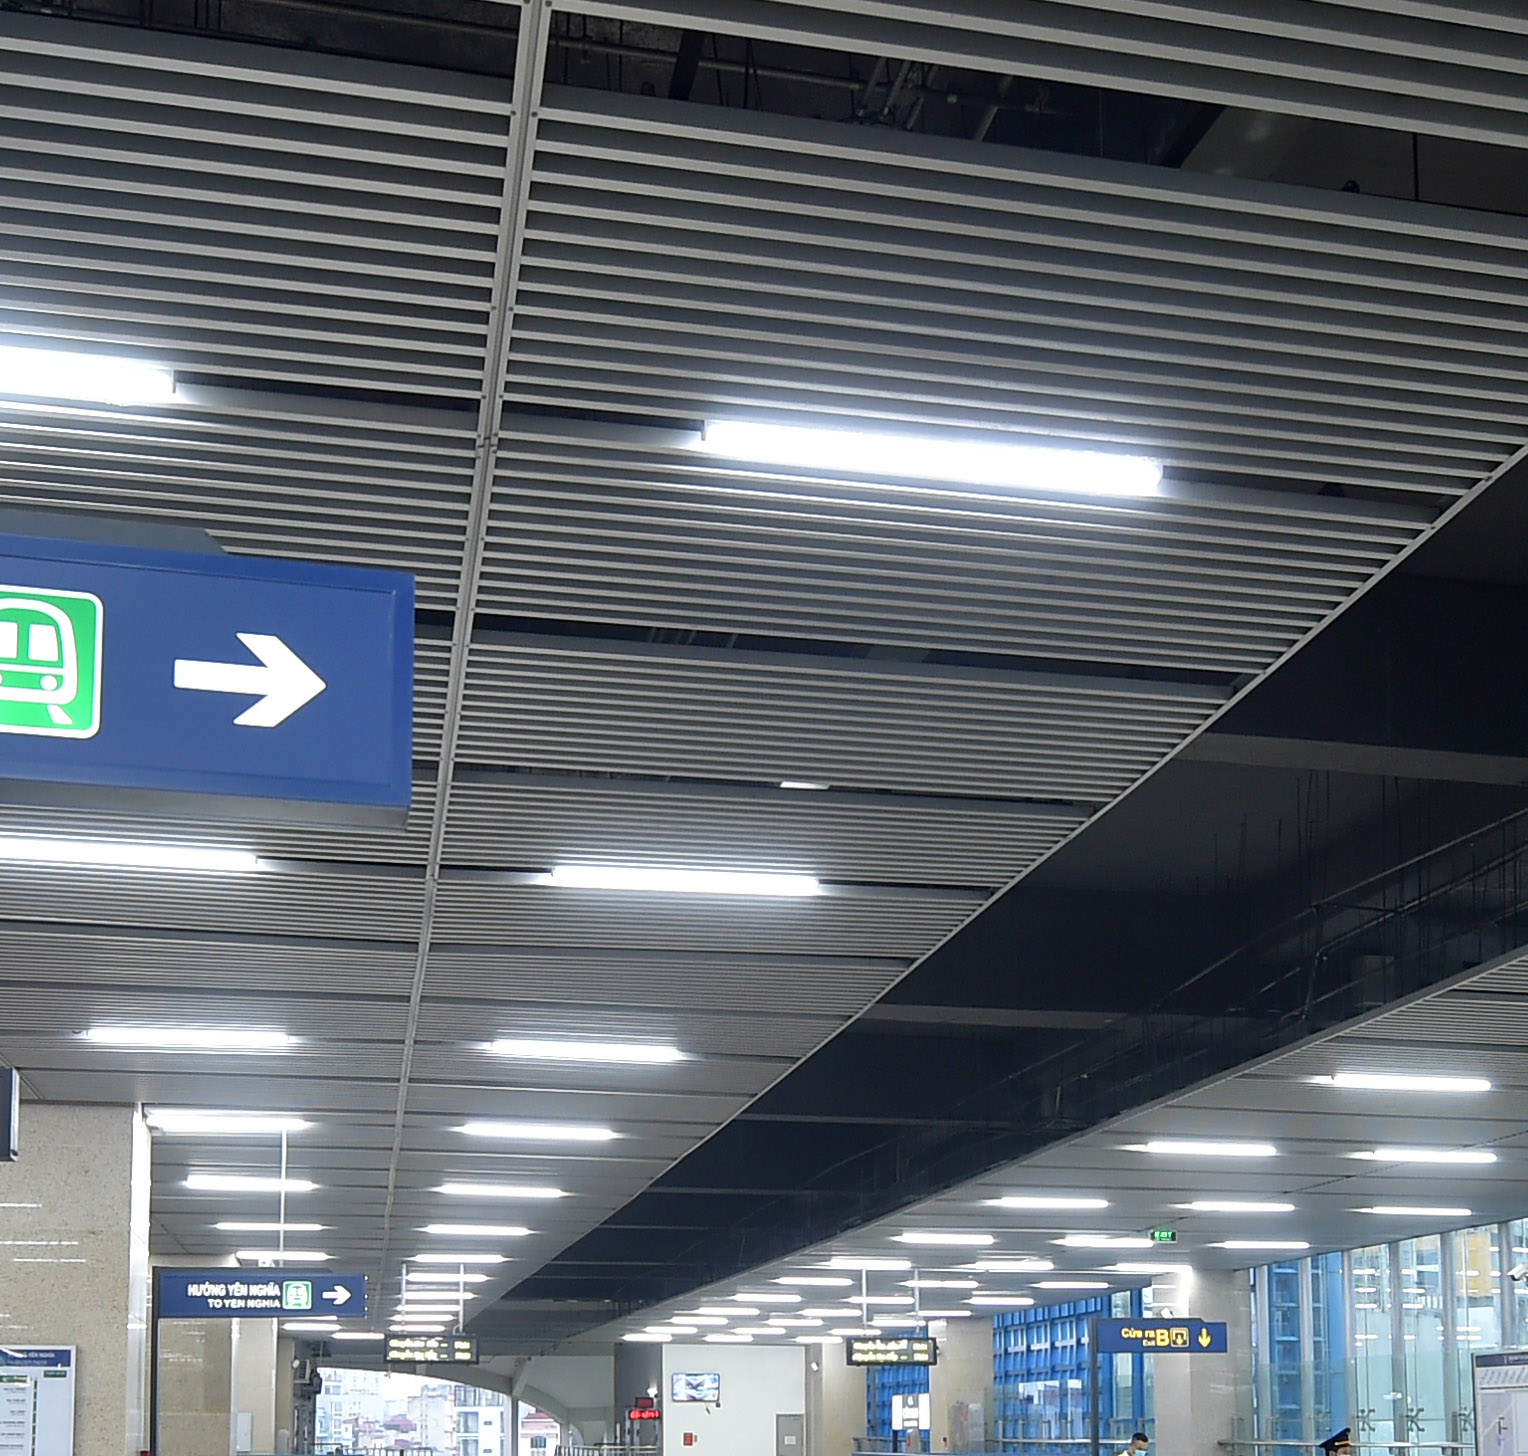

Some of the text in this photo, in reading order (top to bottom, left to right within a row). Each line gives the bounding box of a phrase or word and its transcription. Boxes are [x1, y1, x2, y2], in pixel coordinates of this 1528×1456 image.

[207, 1298, 281, 1308] TO YEN NGHIA
